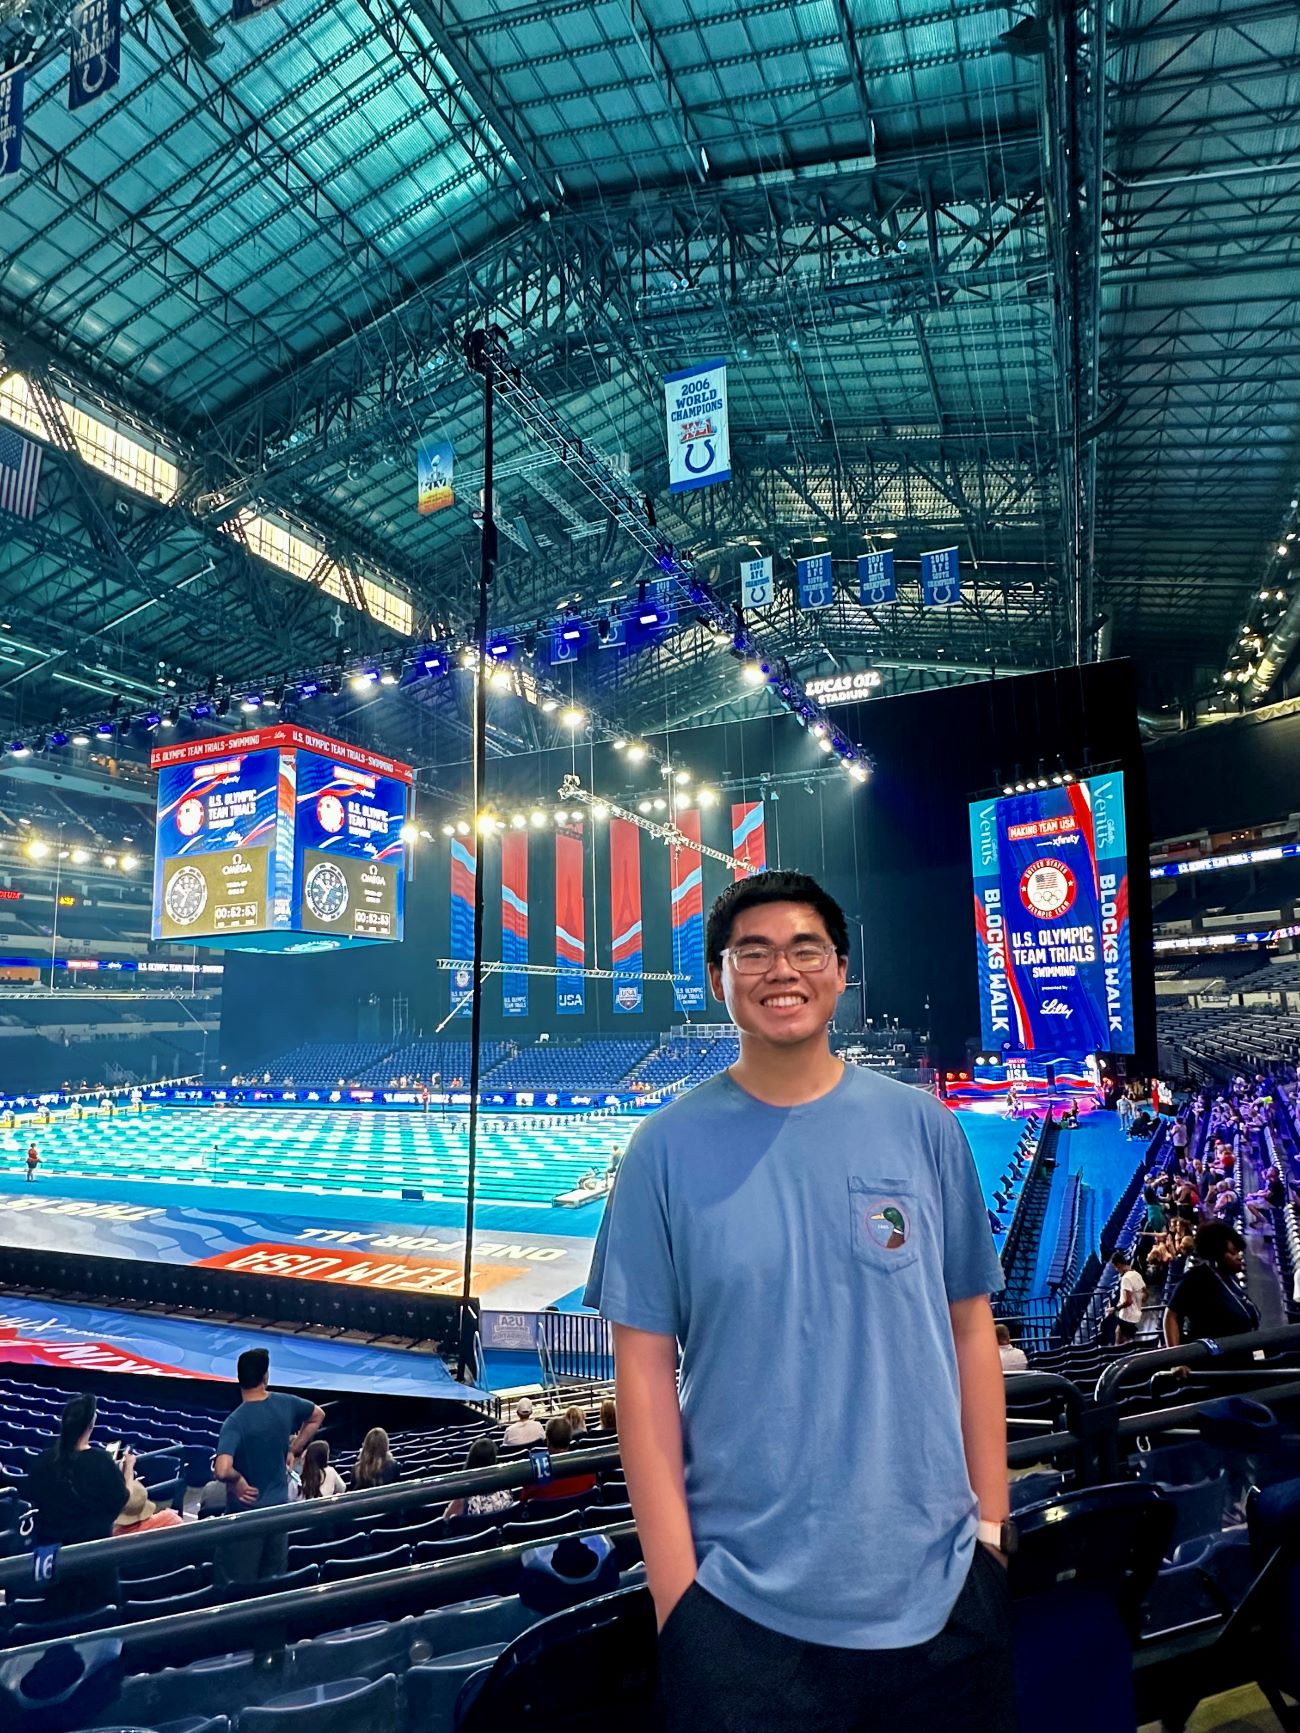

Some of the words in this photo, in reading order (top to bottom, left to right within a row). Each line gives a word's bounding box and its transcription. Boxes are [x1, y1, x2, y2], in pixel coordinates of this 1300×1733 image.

[681, 378, 710, 396] 2006
[676, 389, 717, 410] WORLD
[670, 399, 723, 422] CHAMPIONS
[805, 676, 852, 697] LUCAS
[853, 671, 881, 688] OIL
[818, 688, 869, 704] STADIUM
[162, 748, 187, 760] OLYMPIC
[187, 746, 204, 756] TEAM
[293, 731, 304, 744] U.S.
[306, 734, 330, 752] OLYMPIC
[331, 744, 346, 757] TEAM
[224, 790, 257, 806] OLYMPIC
[208, 806, 229, 820] TEAM
[1093, 781, 1114, 848] Venus
[980, 804, 996, 866] Venus
[1010, 825, 1038, 838] MAKING
[1039, 821, 1058, 832] TEAM
[1060, 817, 1076, 829] USA
[1052, 834, 1080, 846] xfinity
[222, 864, 252, 876] OMEGA
[361, 873, 386, 886] OMEGA
[1025, 861, 1044, 878] UNITED
[1046, 860, 1068, 874] STATES
[1028, 904, 1052, 918] OLYMPIC
[1055, 900, 1070, 916] TEAM
[1100, 874, 1118, 963] BLOCKS
[984, 888, 1005, 970] BLOCKS
[1012, 932, 1036, 948] U.S.
[1038, 926, 1094, 946] OLYMPIC
[1012, 948, 1046, 966] TEAM
[1048, 944, 1096, 963] TRIALS
[1032, 966, 1076, 978] SWIMMING
[558, 994, 583, 1006] USA
[989, 974, 1010, 1032] WALK
[1040, 998, 1074, 1019] Lilly
[1104, 968, 1122, 1032] WALK
[1006, 1069, 1029, 1081] USA
[40, 1202, 168, 1221] THIS
[293, 1228, 382, 1244] ALL
[370, 1235, 465, 1252] FOR
[473, 1242, 568, 1262] ONE
[224, 1251, 342, 1276] USA
[324, 1261, 480, 1294] TEAM
[536, 1457, 550, 1478] 15
[35, 1554, 54, 1582] 16
